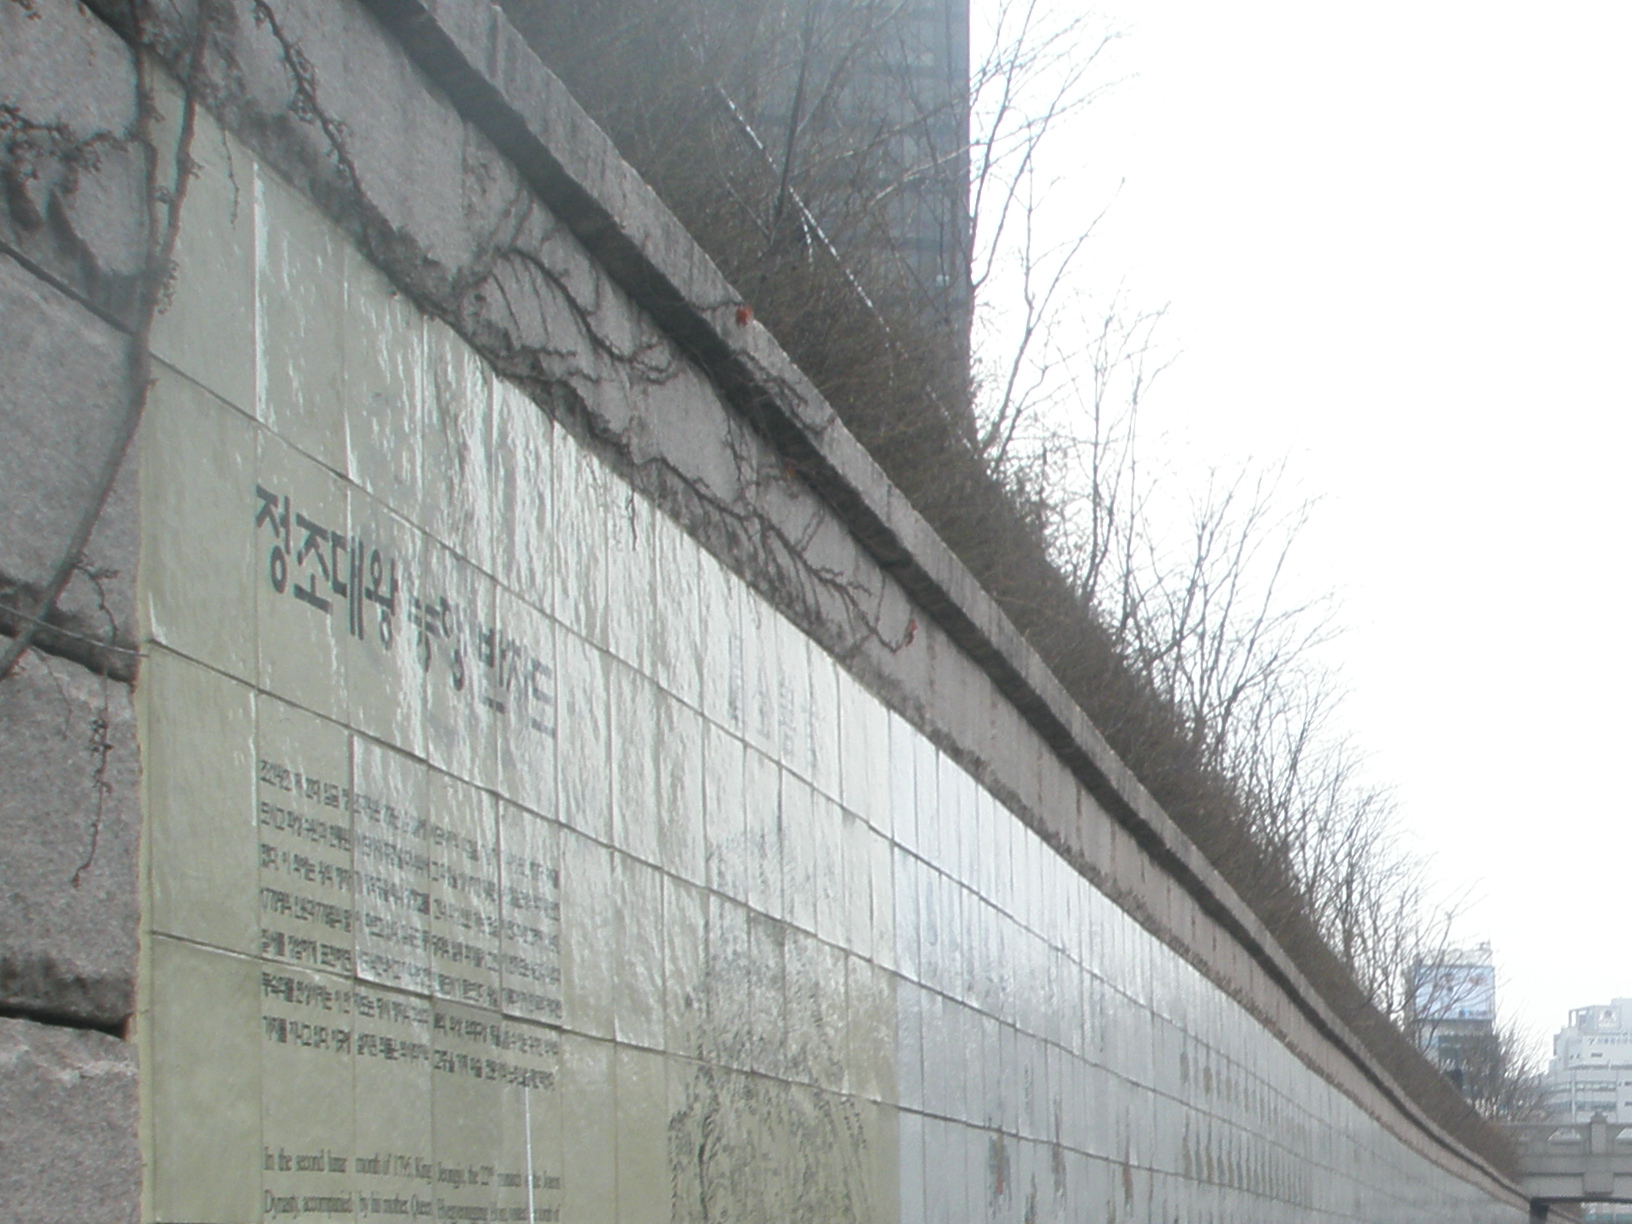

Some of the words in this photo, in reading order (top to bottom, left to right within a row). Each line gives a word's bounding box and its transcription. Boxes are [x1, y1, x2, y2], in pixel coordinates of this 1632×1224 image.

[256, 484, 399, 651] 정조대왕
[277, 1147, 292, 1172] the
[295, 1148, 324, 1173] second
